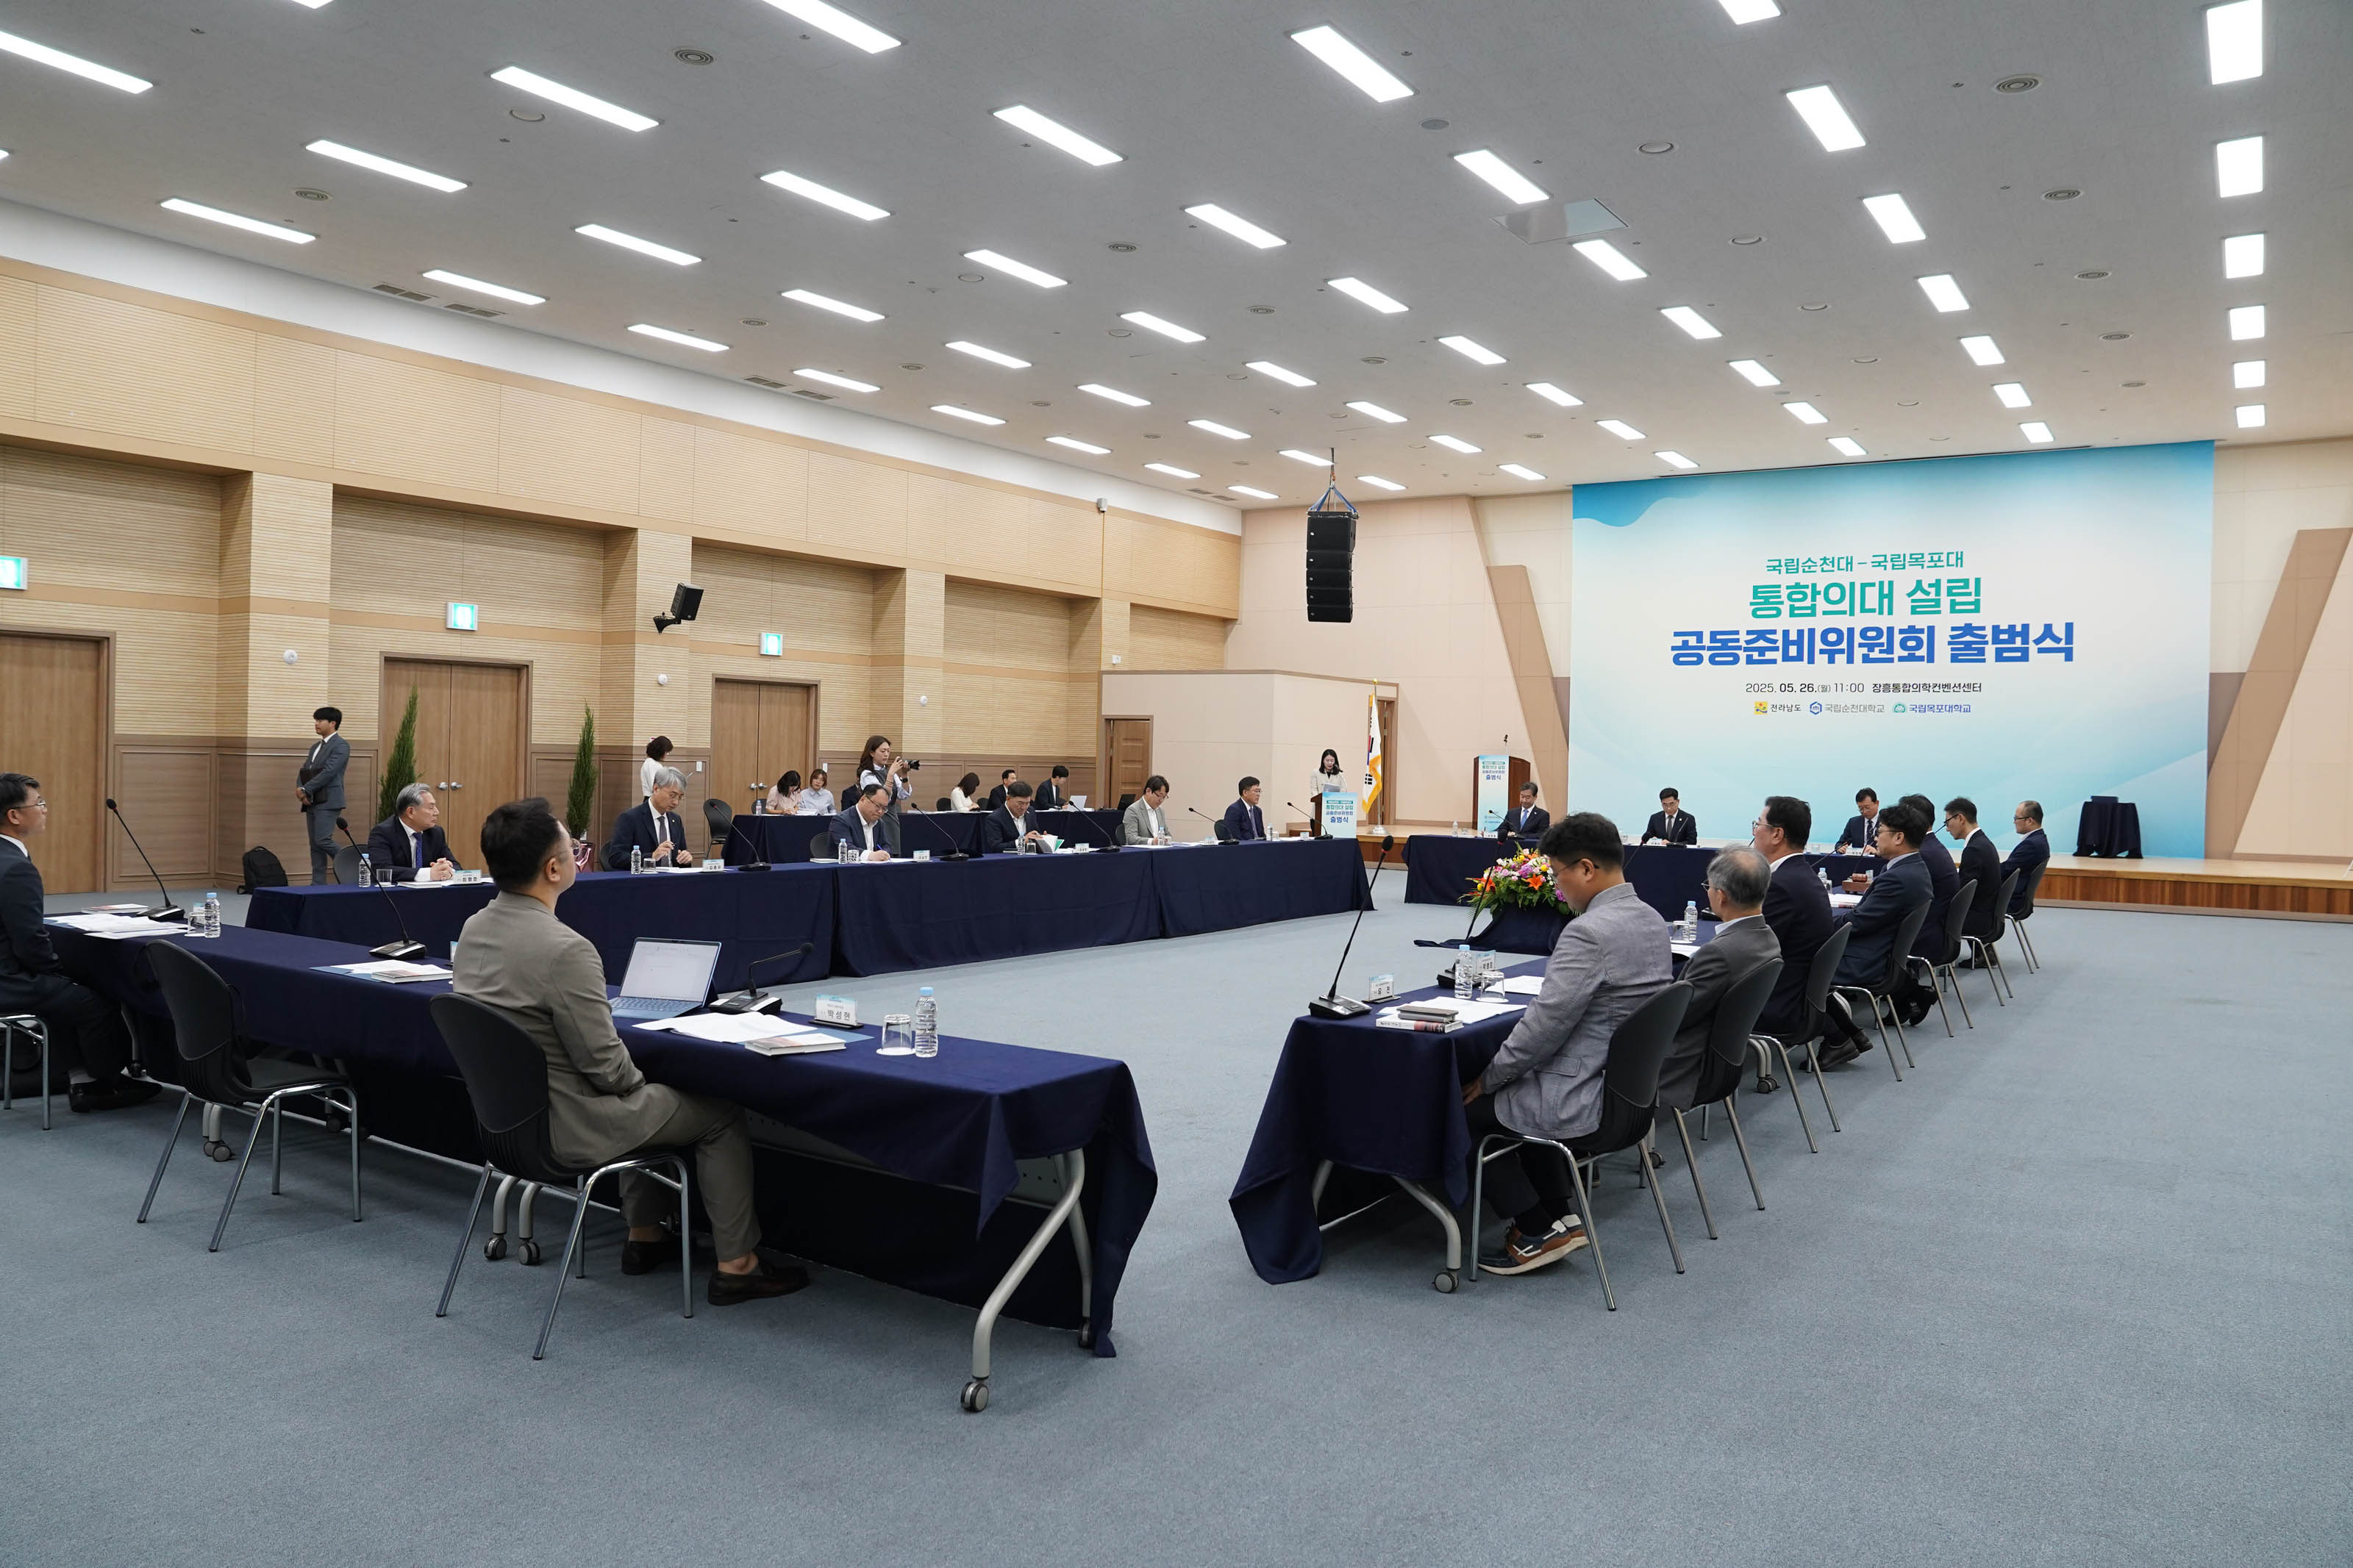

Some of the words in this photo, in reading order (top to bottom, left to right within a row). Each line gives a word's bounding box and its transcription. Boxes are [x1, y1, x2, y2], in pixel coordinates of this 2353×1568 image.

[1749, 580, 1895, 619] 통합의대
[1905, 577, 1982, 615] 설립
[1670, 625, 1936, 666] 공동준비위원회
[1946, 622, 2074, 663] 출범식
[1746, 683, 1777, 693] 2025.
[1779, 683, 1797, 693] 05.
[1834, 683, 1865, 693] 11:00
[1871, 682, 1982, 693] 장흥통합의학컨벤션센터
[1770, 704, 1802, 712] 전라남도
[1824, 704, 1885, 713] 국립순천대학교
[1909, 704, 1971, 713] 국립목포대학교
